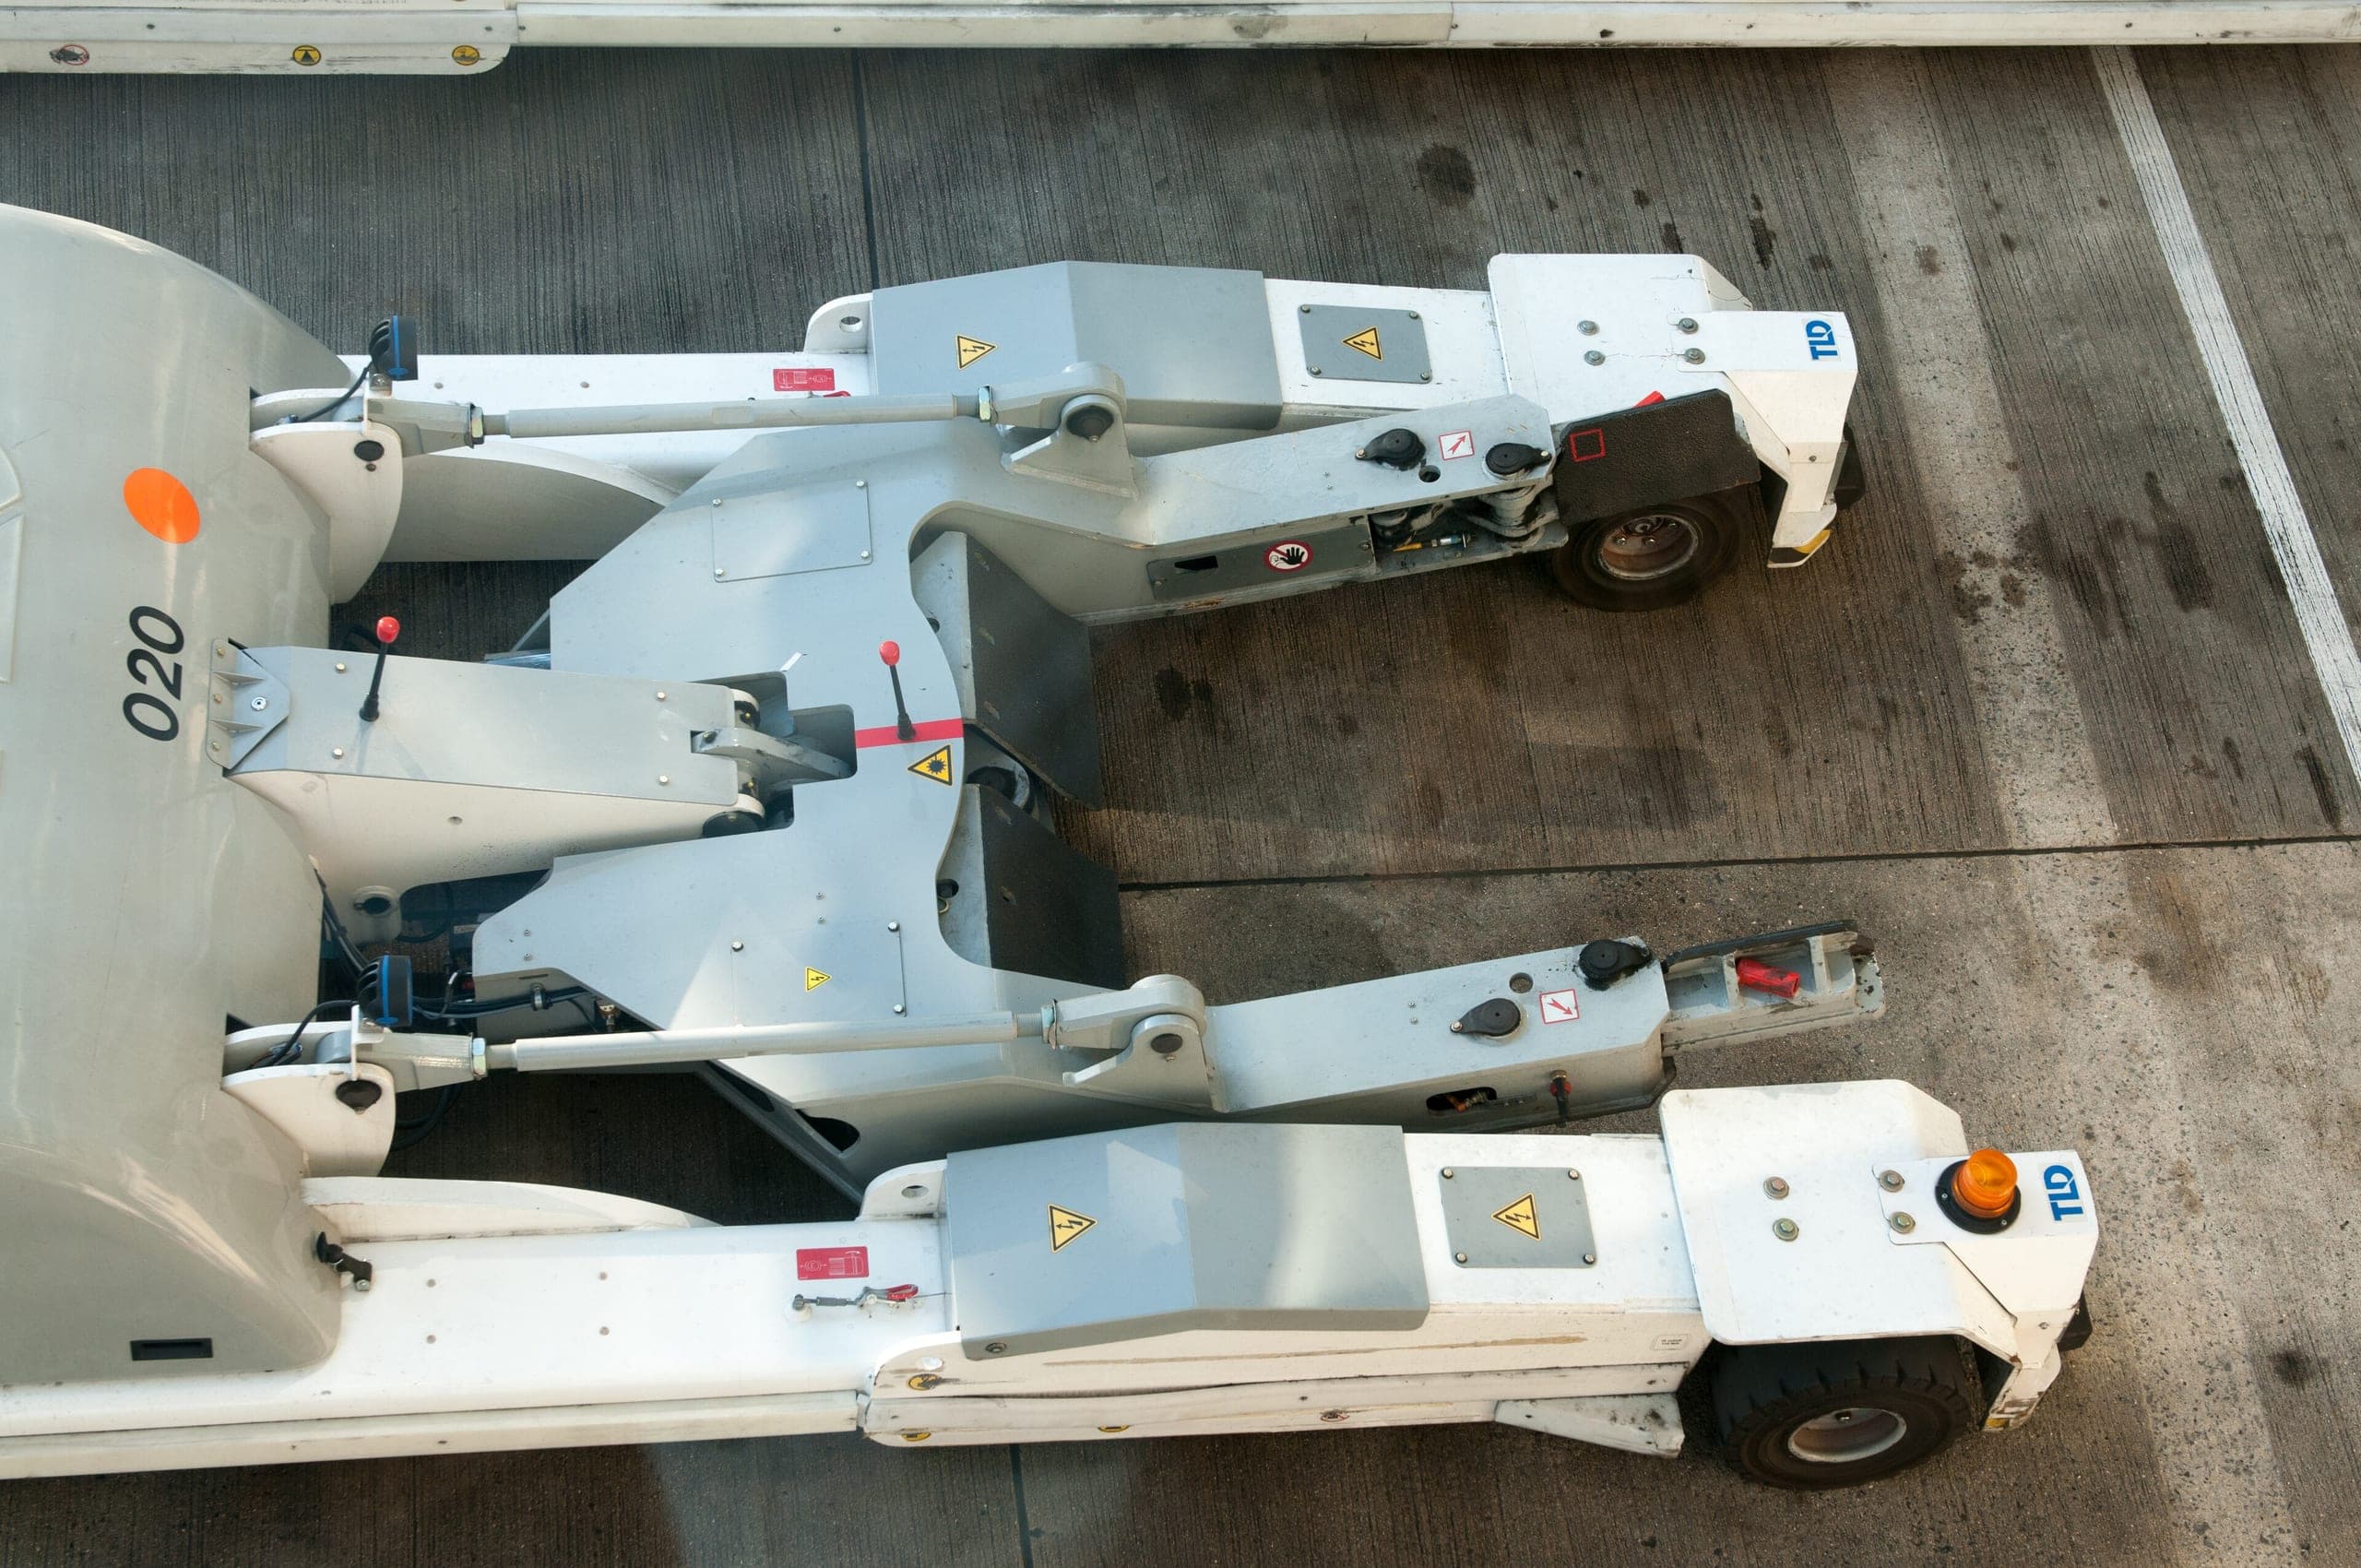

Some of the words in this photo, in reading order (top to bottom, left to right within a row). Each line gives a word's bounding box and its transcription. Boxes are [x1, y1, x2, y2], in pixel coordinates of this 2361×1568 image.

[1806, 320, 1838, 360] TLD
[123, 606, 184, 742] 020
[2043, 1165, 2084, 1221] TLD
